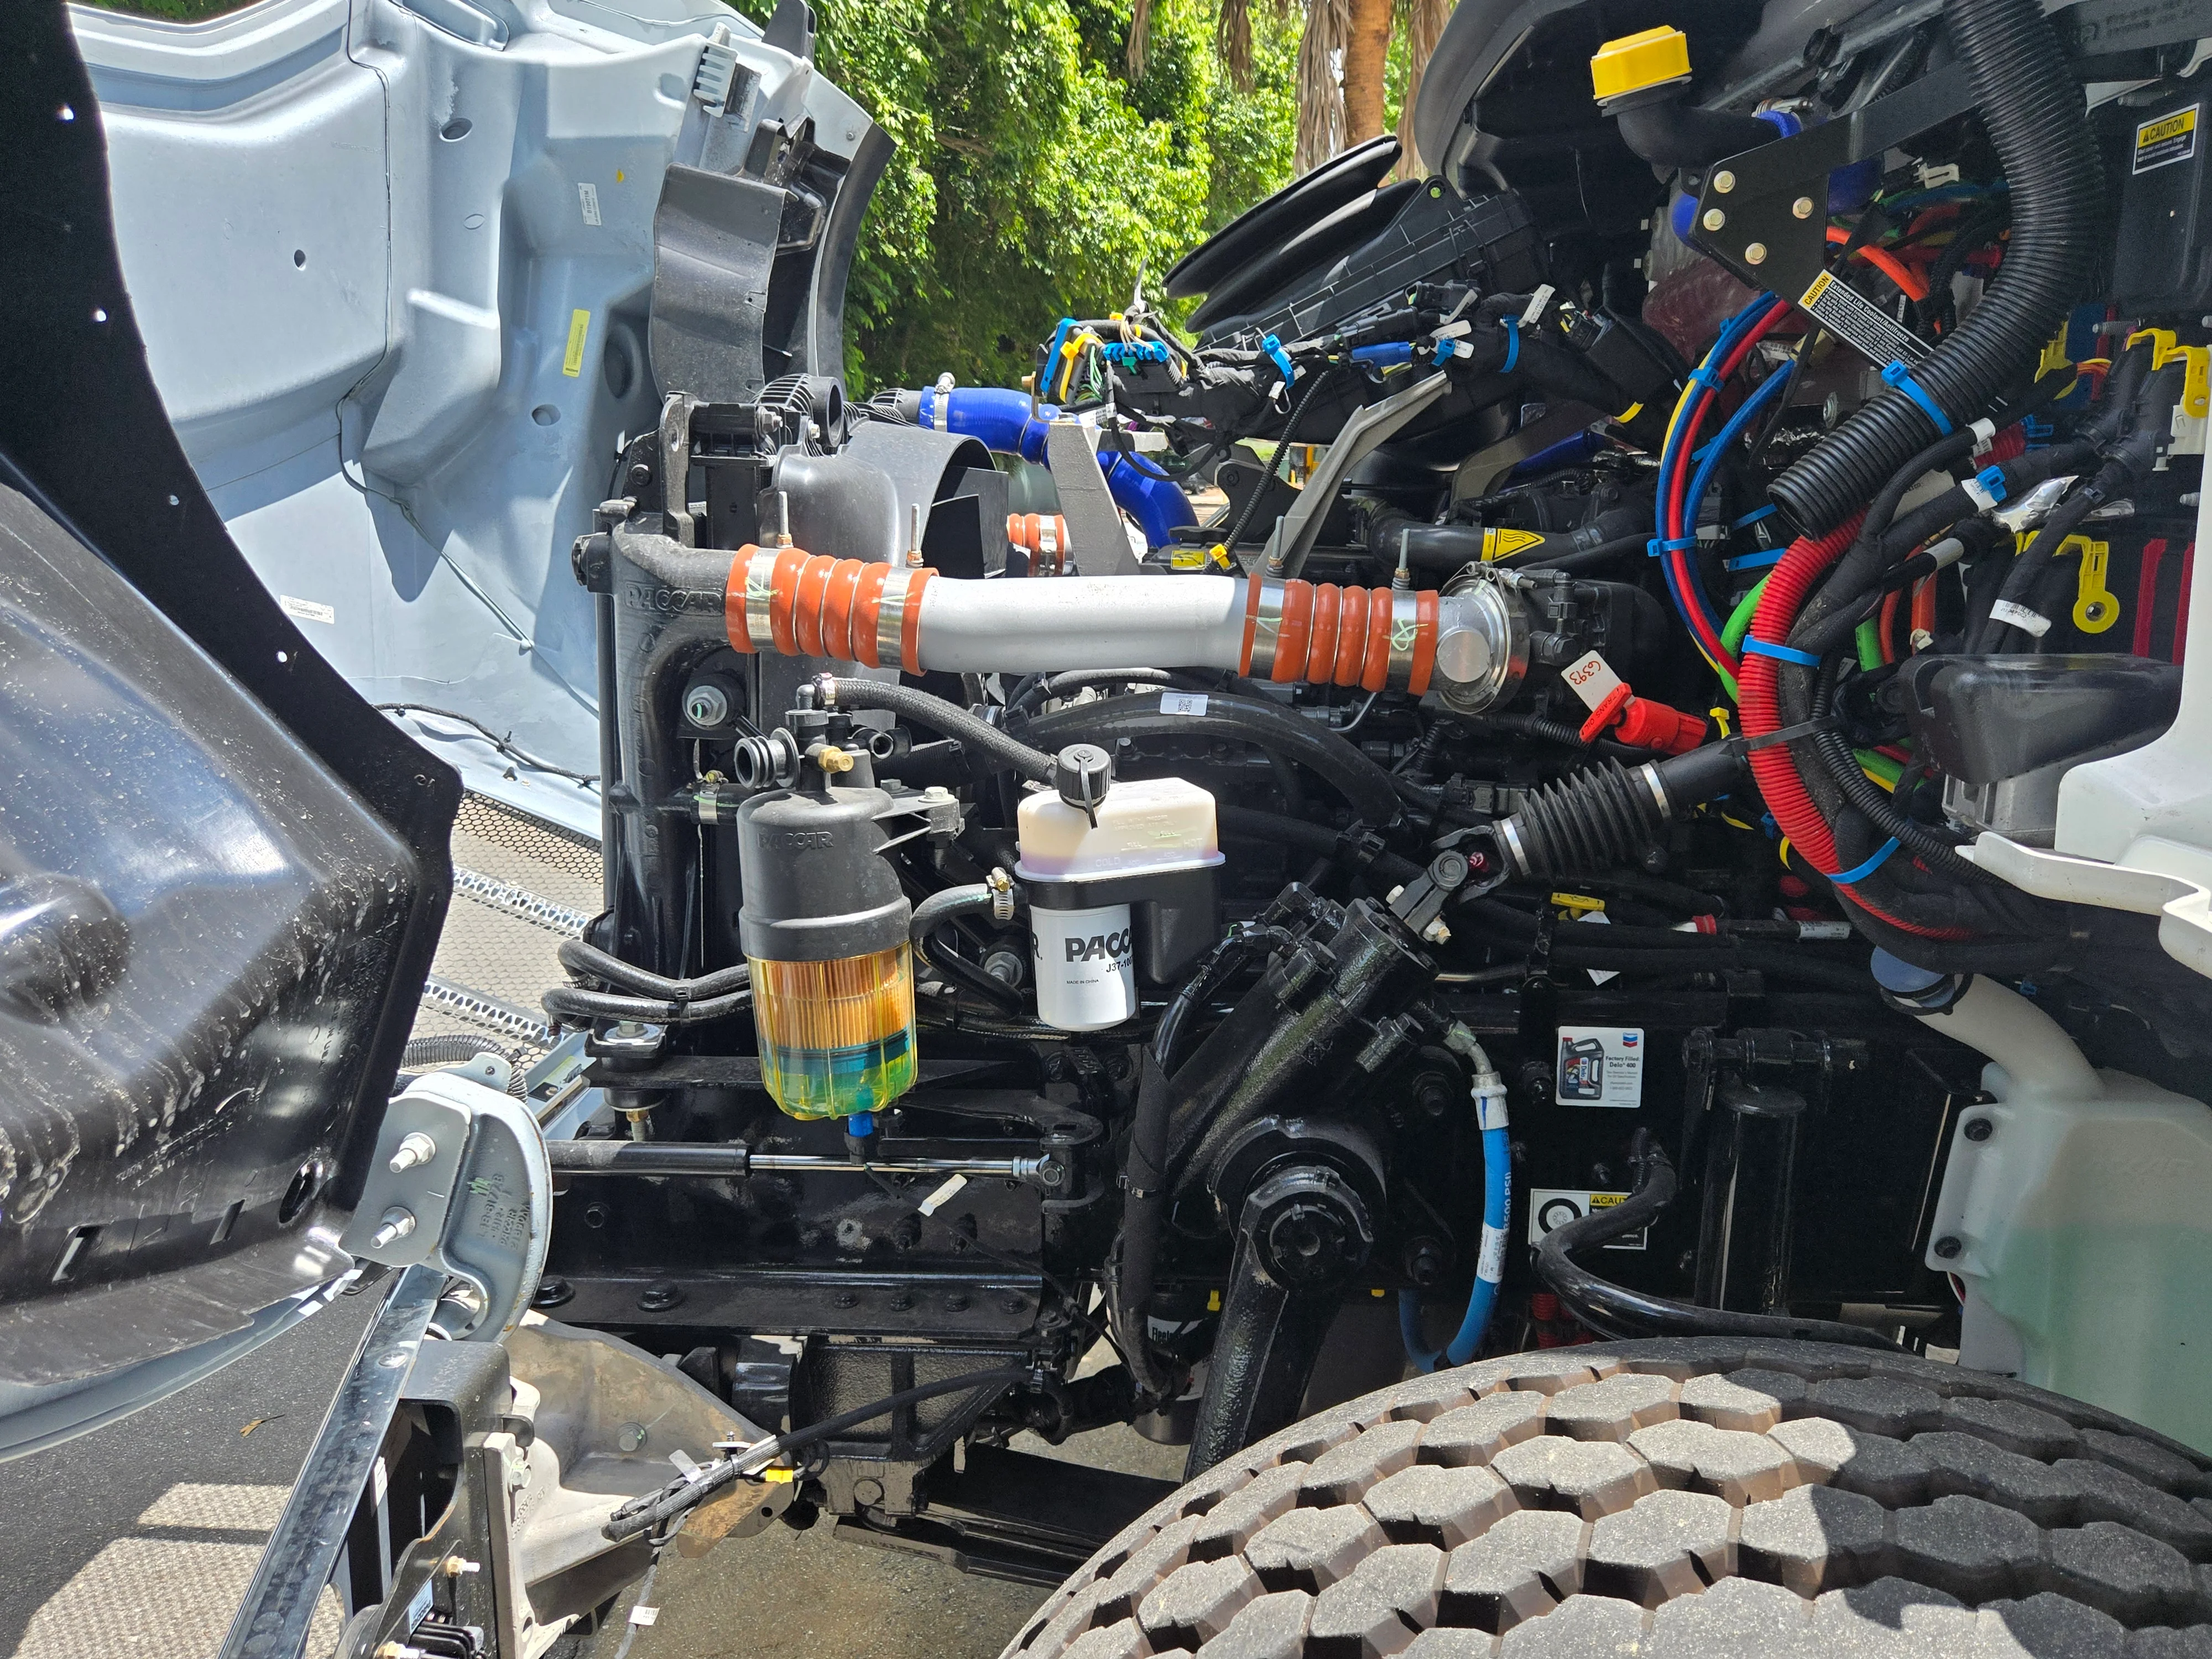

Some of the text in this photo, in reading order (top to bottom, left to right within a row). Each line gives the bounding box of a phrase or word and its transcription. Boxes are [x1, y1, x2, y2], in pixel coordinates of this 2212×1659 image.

[2150, 117, 2184, 140] CAUTION
[1804, 275, 1829, 306] CAUTION
[1830, 281, 1854, 301] Extended
[1853, 298, 1865, 309] Life
[1863, 305, 1910, 343] Coolant/Antifreeze
[625, 584, 723, 613] PACCAR
[1569, 661, 1601, 685] 6393
[1584, 696, 1617, 731] TRANS OIL
[757, 831, 834, 850] PACCAR
[1183, 838, 1203, 850] HOT
[1095, 857, 1120, 867] COLD
[1065, 927, 1132, 962] PACC
